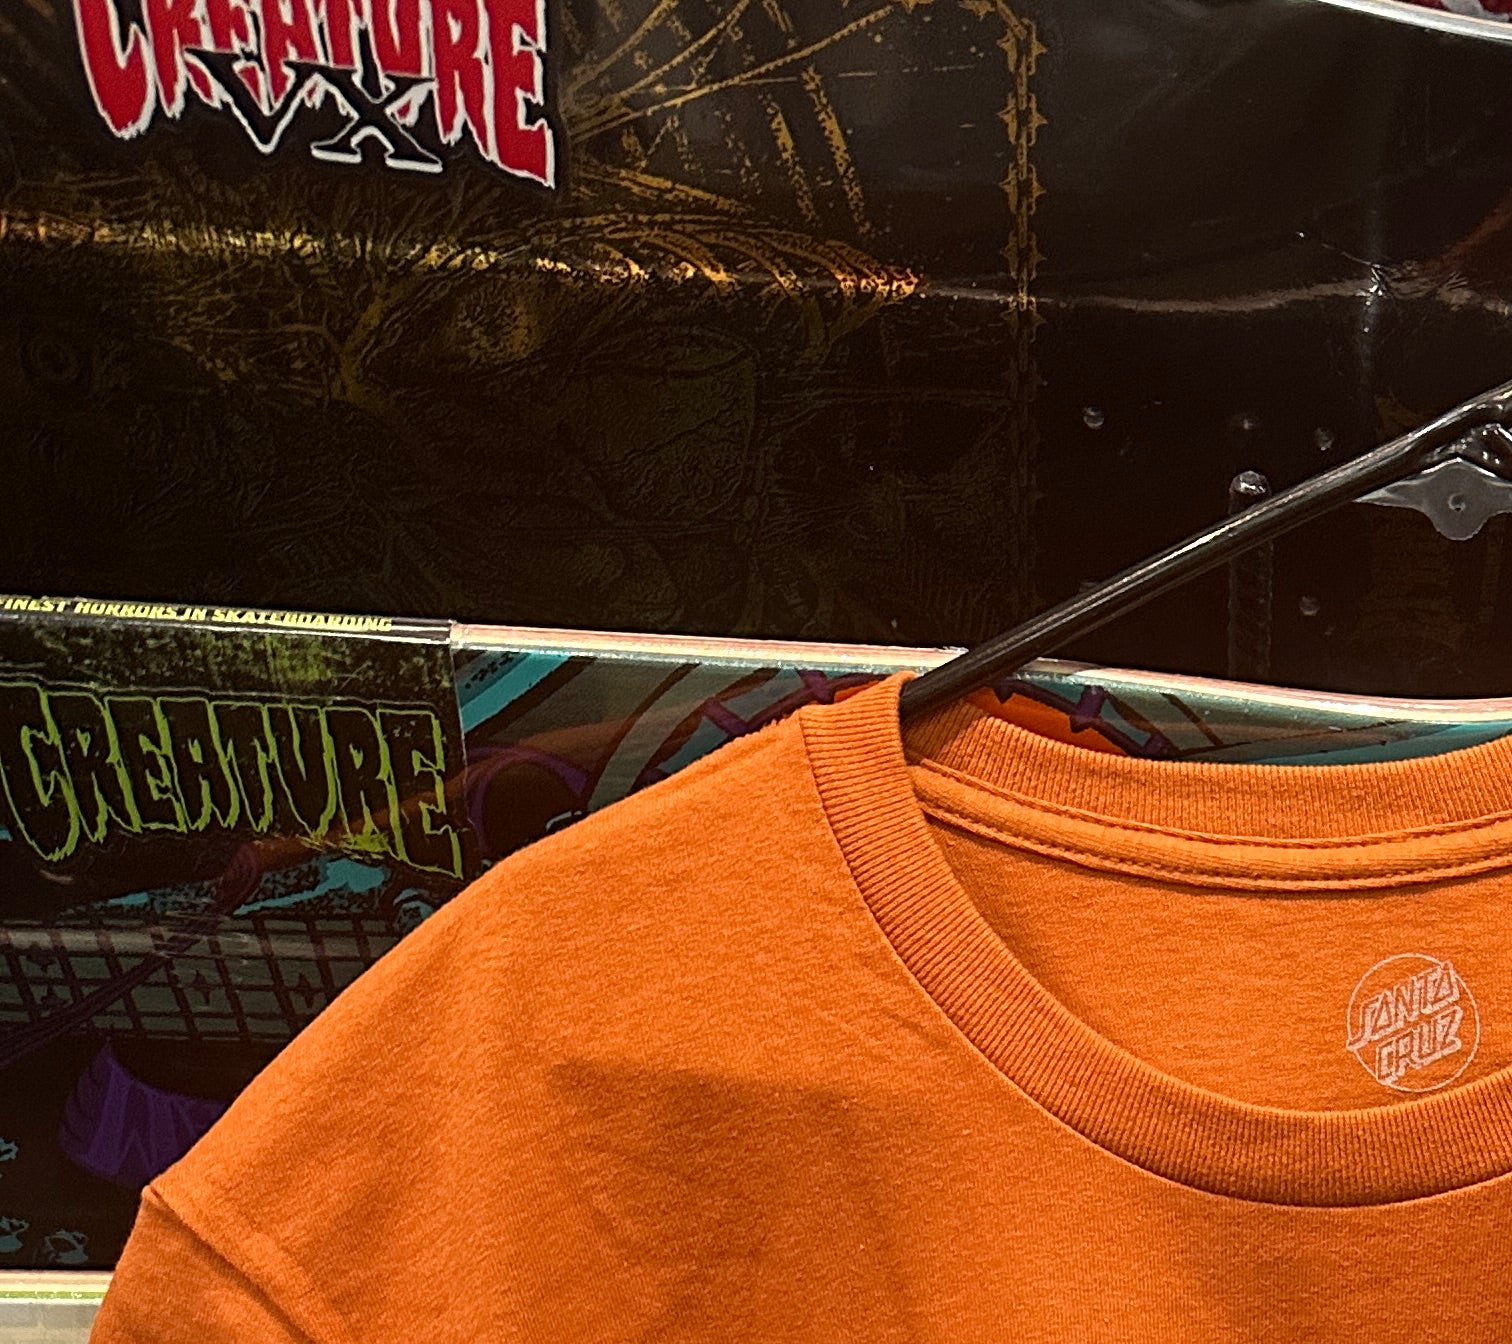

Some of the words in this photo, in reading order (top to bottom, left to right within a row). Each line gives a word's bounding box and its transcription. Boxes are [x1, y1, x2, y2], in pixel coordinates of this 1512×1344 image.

[0, 599, 71, 613] INEST
[73, 601, 178, 619] HORRORS
[179, 607, 208, 621] IN
[211, 608, 394, 633] SKATEBOARDING
[0, 682, 464, 880] CREATURE
[1346, 960, 1461, 1050] SANTA
[1376, 1004, 1464, 1085] CRUZ
